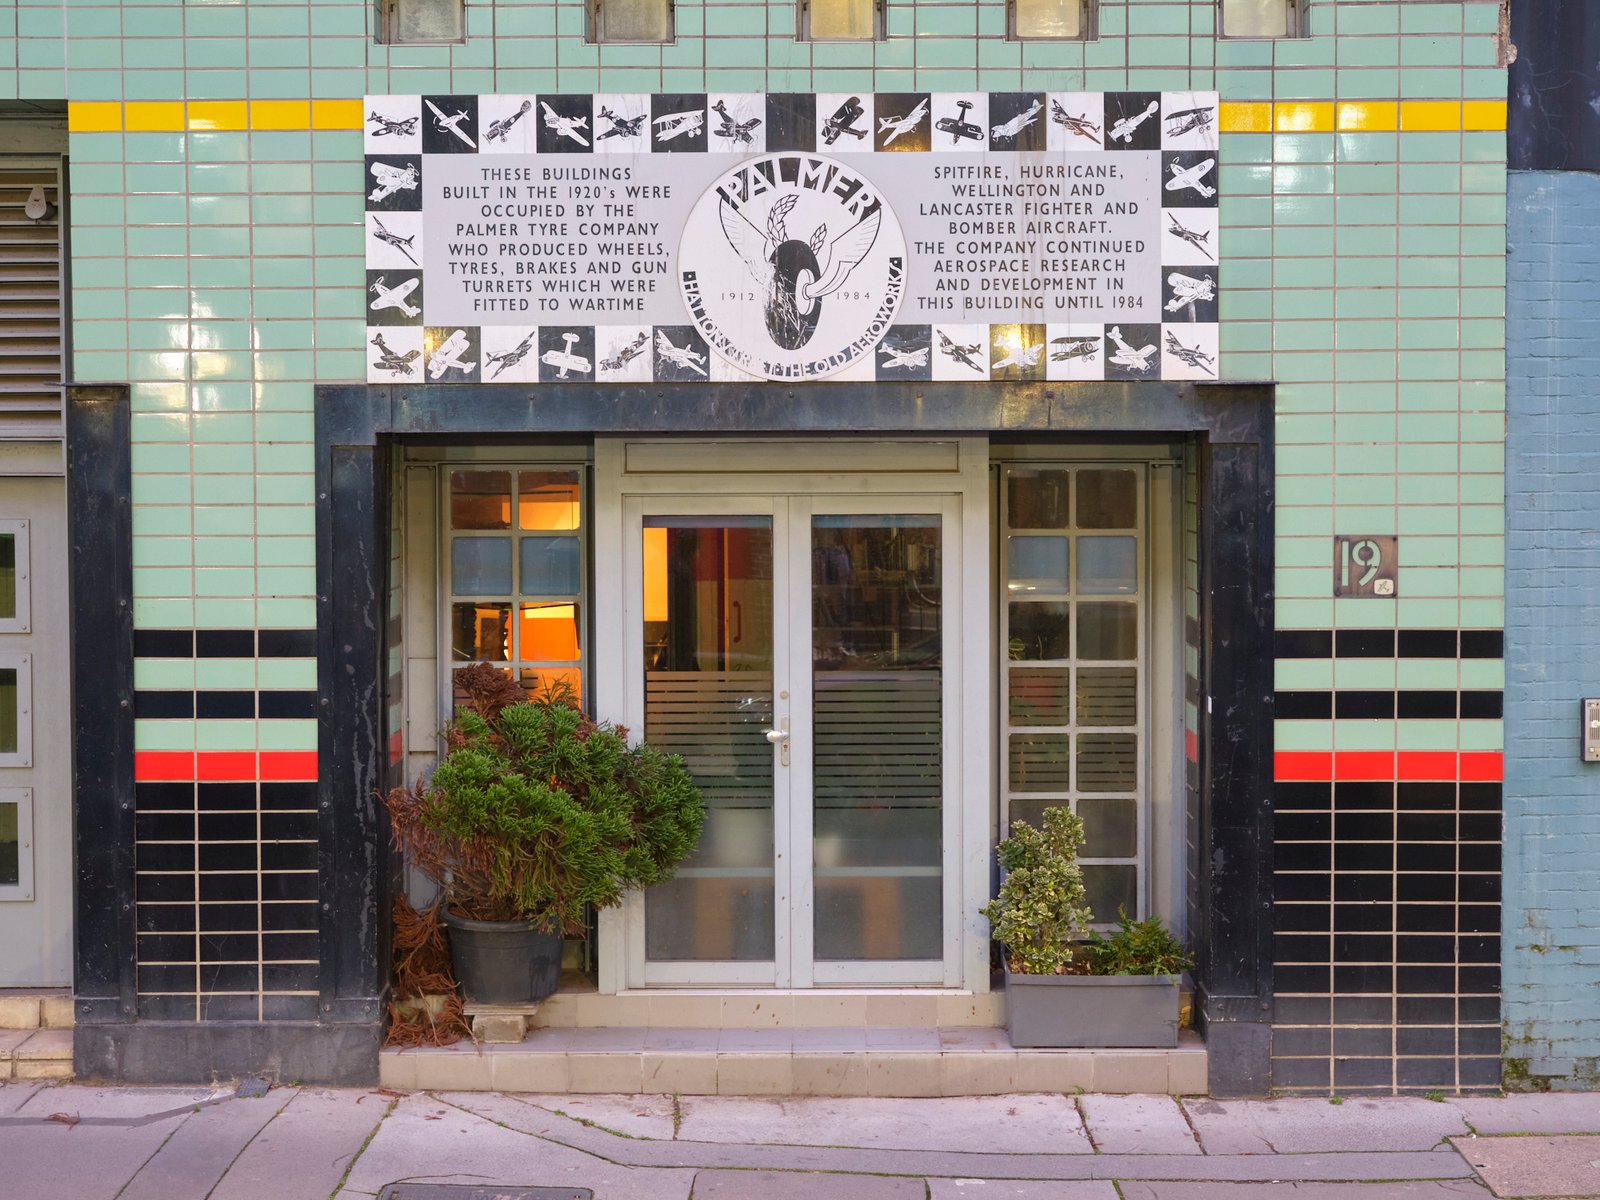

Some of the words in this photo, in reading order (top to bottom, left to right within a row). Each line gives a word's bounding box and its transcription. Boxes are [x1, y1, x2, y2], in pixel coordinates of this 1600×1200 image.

[480, 168, 531, 181] THESE
[542, 167, 631, 181] BUILDINGS
[934, 165, 1008, 181] SPITFIRE,
[1020, 165, 1124, 180] HURRICANE,
[443, 186, 490, 199] BUILT
[499, 186, 516, 199] IN
[526, 186, 557, 199] THE
[569, 185, 615, 199] 1920's
[625, 185, 671, 199] WERE
[717, 157, 881, 222] PALMER
[951, 183, 1060, 197] WELLINGTON
[1070, 183, 1105, 197] AND
[481, 204, 565, 218] OCCUPIED
[576, 204, 595, 217] BY
[603, 204, 634, 217] THE
[920, 202, 1014, 216] LANCASTER
[1024, 202, 1093, 216] FIGHTER
[1103, 202, 1139, 215] AND
[456, 223, 519, 236] PALMER
[527, 223, 568, 236] TYRE
[578, 222, 659, 236] COMPANY
[949, 221, 1016, 235] BOMBER
[1025, 220, 1112, 234] AIRCRAFT.
[448, 243, 488, 256] WHO
[499, 242, 588, 256] PRODUCED
[597, 242, 670, 257] WHEELS,
[914, 241, 945, 255] THE
[956, 240, 1037, 255] COMPANY
[1046, 240, 1145, 254] CONTINUED
[448, 261, 504, 276] TYRES,
[516, 261, 577, 275] BRAKES
[586, 261, 622, 274] AND
[631, 261, 667, 274] GUN
[933, 259, 1029, 273] AEROSPACE
[1040, 258, 1125, 272] RESEARCH
[462, 279, 532, 293] TURRETS
[542, 279, 600, 293] WHICH
[610, 279, 656, 293] WERE
[935, 278, 970, 291] AND
[981, 277, 1097, 291] DEVELOPMENT
[1107, 277, 1124, 290] IN
[721, 292, 755, 301] 1912
[836, 291, 871, 300] 1984
[917, 296, 954, 310] THIS
[965, 296, 1044, 310] BUILDING
[1055, 295, 1104, 309] UNTIL
[1113, 295, 1143, 309] 1984
[474, 298, 529, 312] FITTED
[538, 298, 559, 311] TO
[568, 297, 644, 311] WARTIME
[684, 281, 725, 346] HATTON
[814, 350, 848, 373] OLD
[848, 261, 902, 360] AEROWORKS
[1341, 540, 1381, 587] 19
